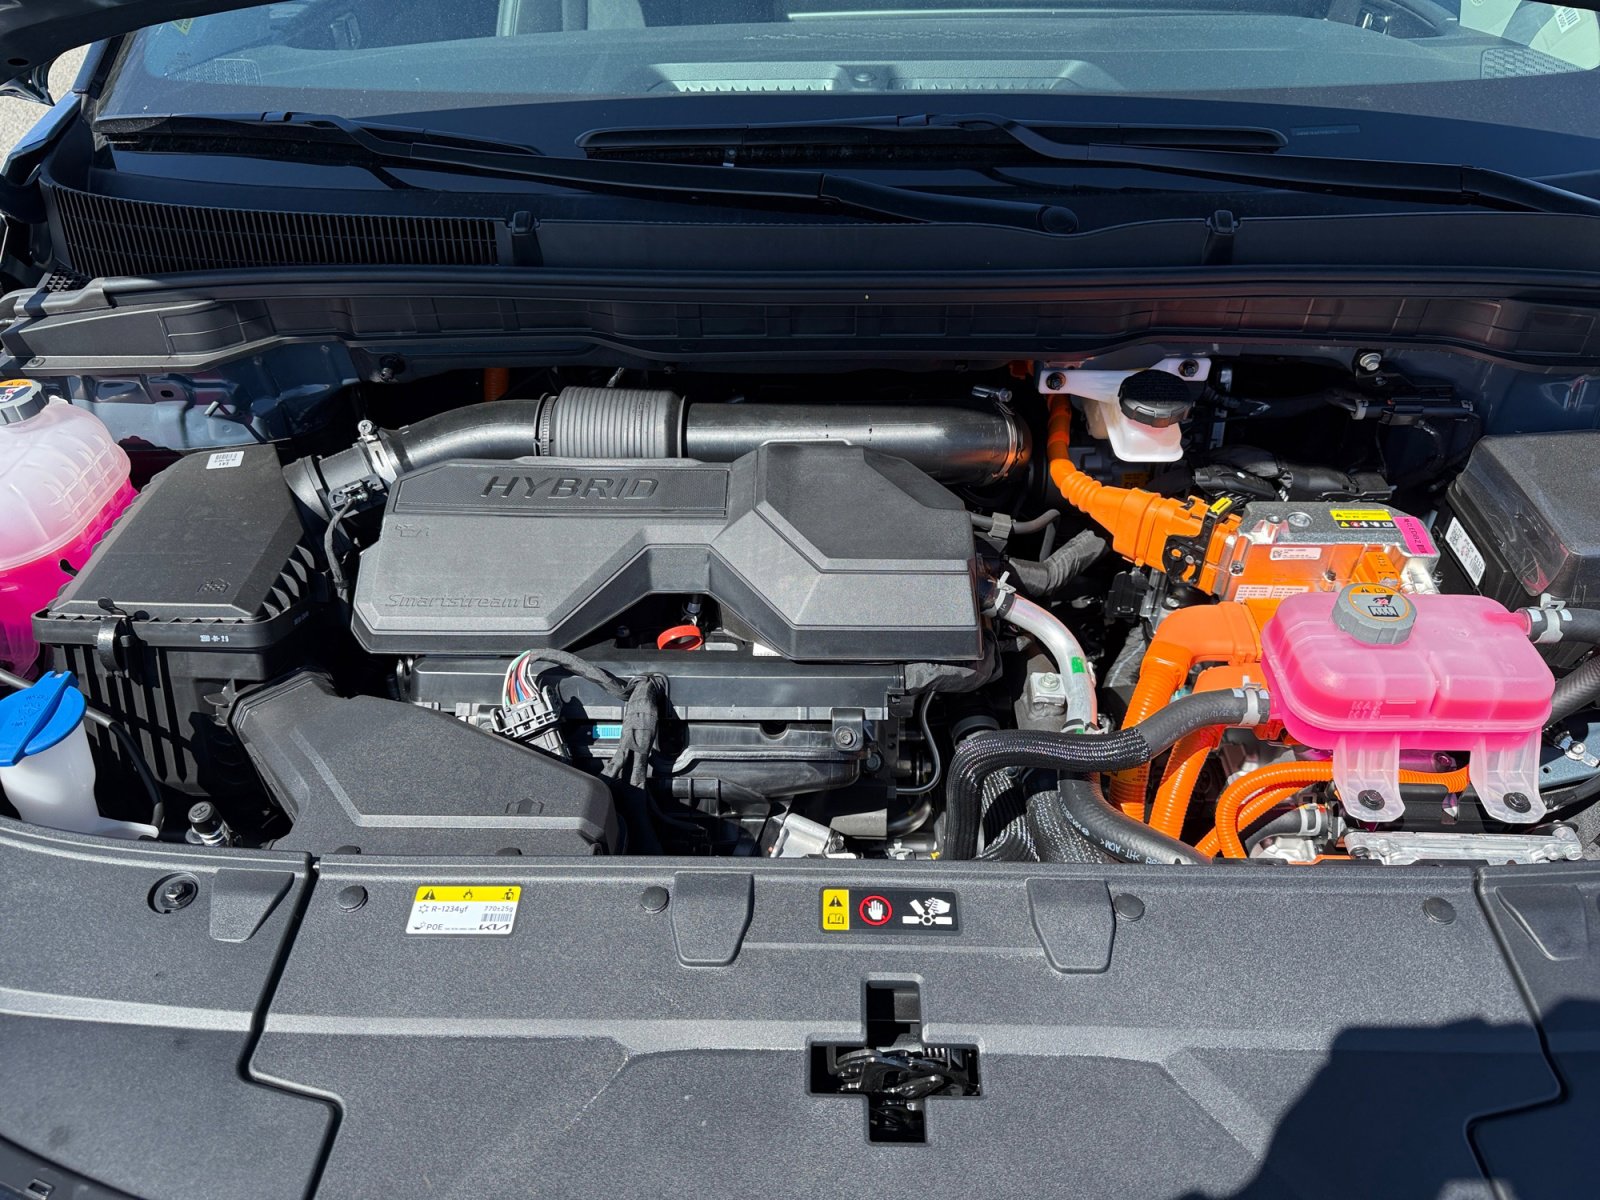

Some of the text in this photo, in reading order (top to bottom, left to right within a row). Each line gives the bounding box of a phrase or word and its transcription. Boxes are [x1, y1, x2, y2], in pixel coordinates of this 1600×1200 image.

[480, 476, 659, 500] HYBRID
[384, 594, 519, 608] Smartstream
[431, 905, 469, 914] R-1234yf
[426, 923, 443, 931] POE
[478, 923, 511, 931] KIA
